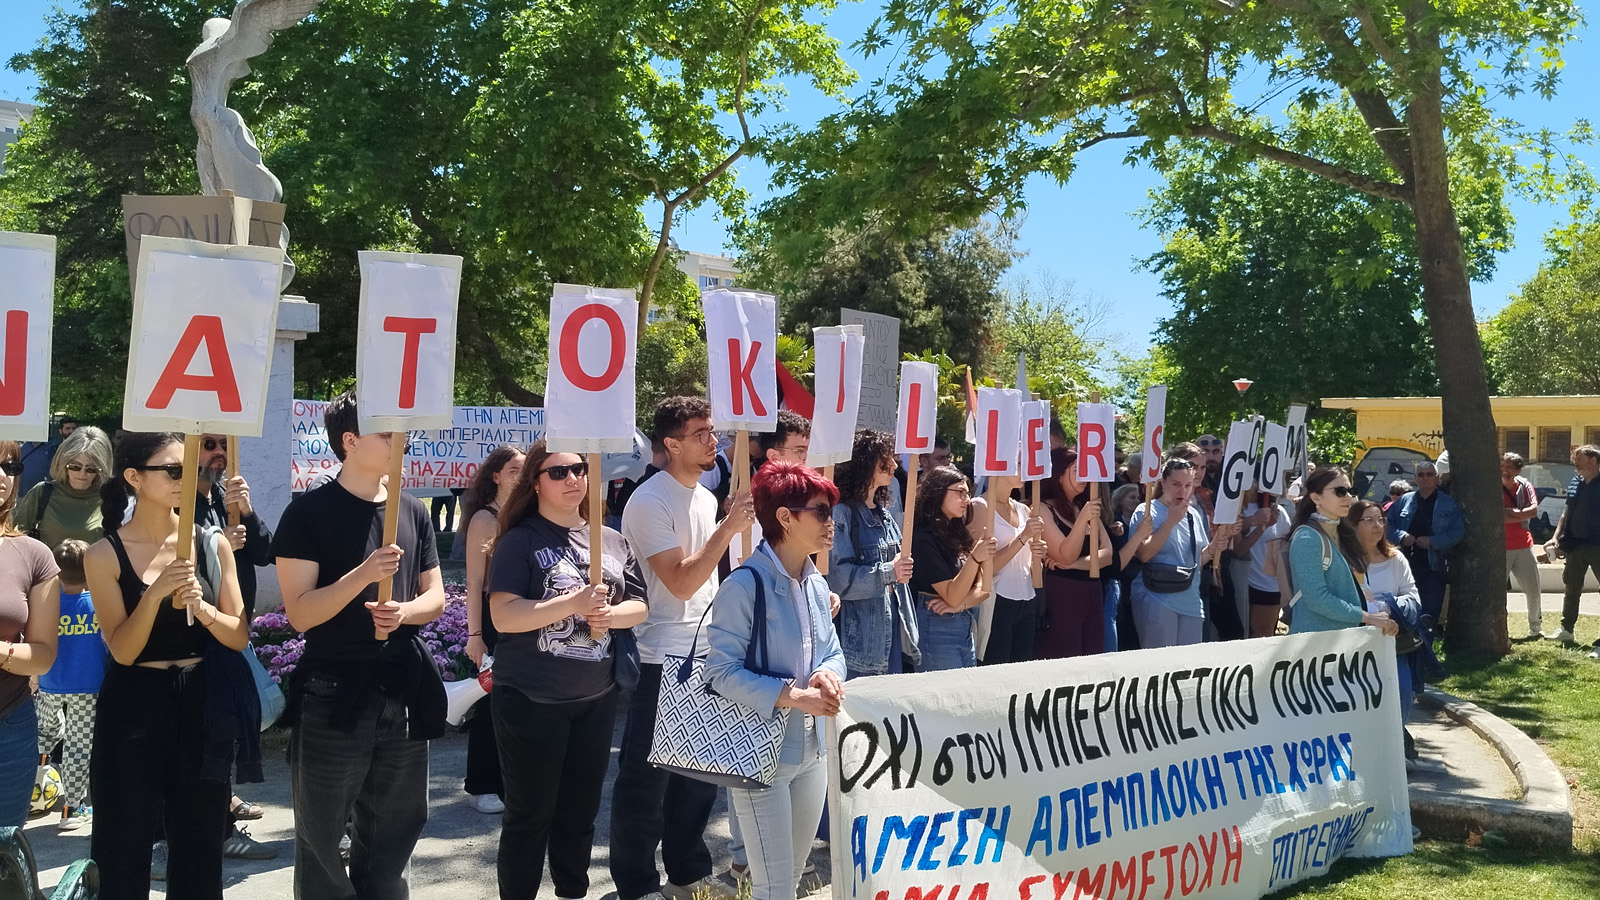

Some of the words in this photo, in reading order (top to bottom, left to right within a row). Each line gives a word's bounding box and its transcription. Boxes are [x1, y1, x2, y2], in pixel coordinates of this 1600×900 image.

[145, 315, 242, 412] A
[383, 316, 437, 409] T
[559, 303, 626, 392] O
[728, 338, 767, 416] K
[439, 427, 546, 443] ΙΜΠΕΡΙΑΛΙΣΤΙΚ
[461, 408, 493, 424] ΤΗΝ
[905, 383, 928, 448] L
[985, 410, 1007, 471] L
[408, 440, 467, 459] ΕΜΟΥΣ
[411, 460, 481, 479] ΜΑΖΙΚΟ
[1027, 418, 1044, 476] E
[1079, 423, 1108, 478] R
[1149, 425, 1162, 478] S
[1248, 420, 1261, 466] O
[1262, 447, 1279, 489] O
[432, 478, 469, 489] ΕΙΡΗ
[1223, 451, 1247, 500] G
[58, 624, 100, 636] OUDLY
[838, 713, 923, 794] ΟΧΙ
[1008, 664, 1259, 774] ΙΜΠΕΡΙΑΛΙΣΤΙΚΟ
[1270, 650, 1383, 718] ΠΟΛΕΜΟ
[851, 804, 1012, 897] ΑΜΕΣΗ
[1024, 754, 1227, 857] ΑΠΕΜΠΛΟΚΗ
[1224, 744, 1287, 800] ΤΗΣ
